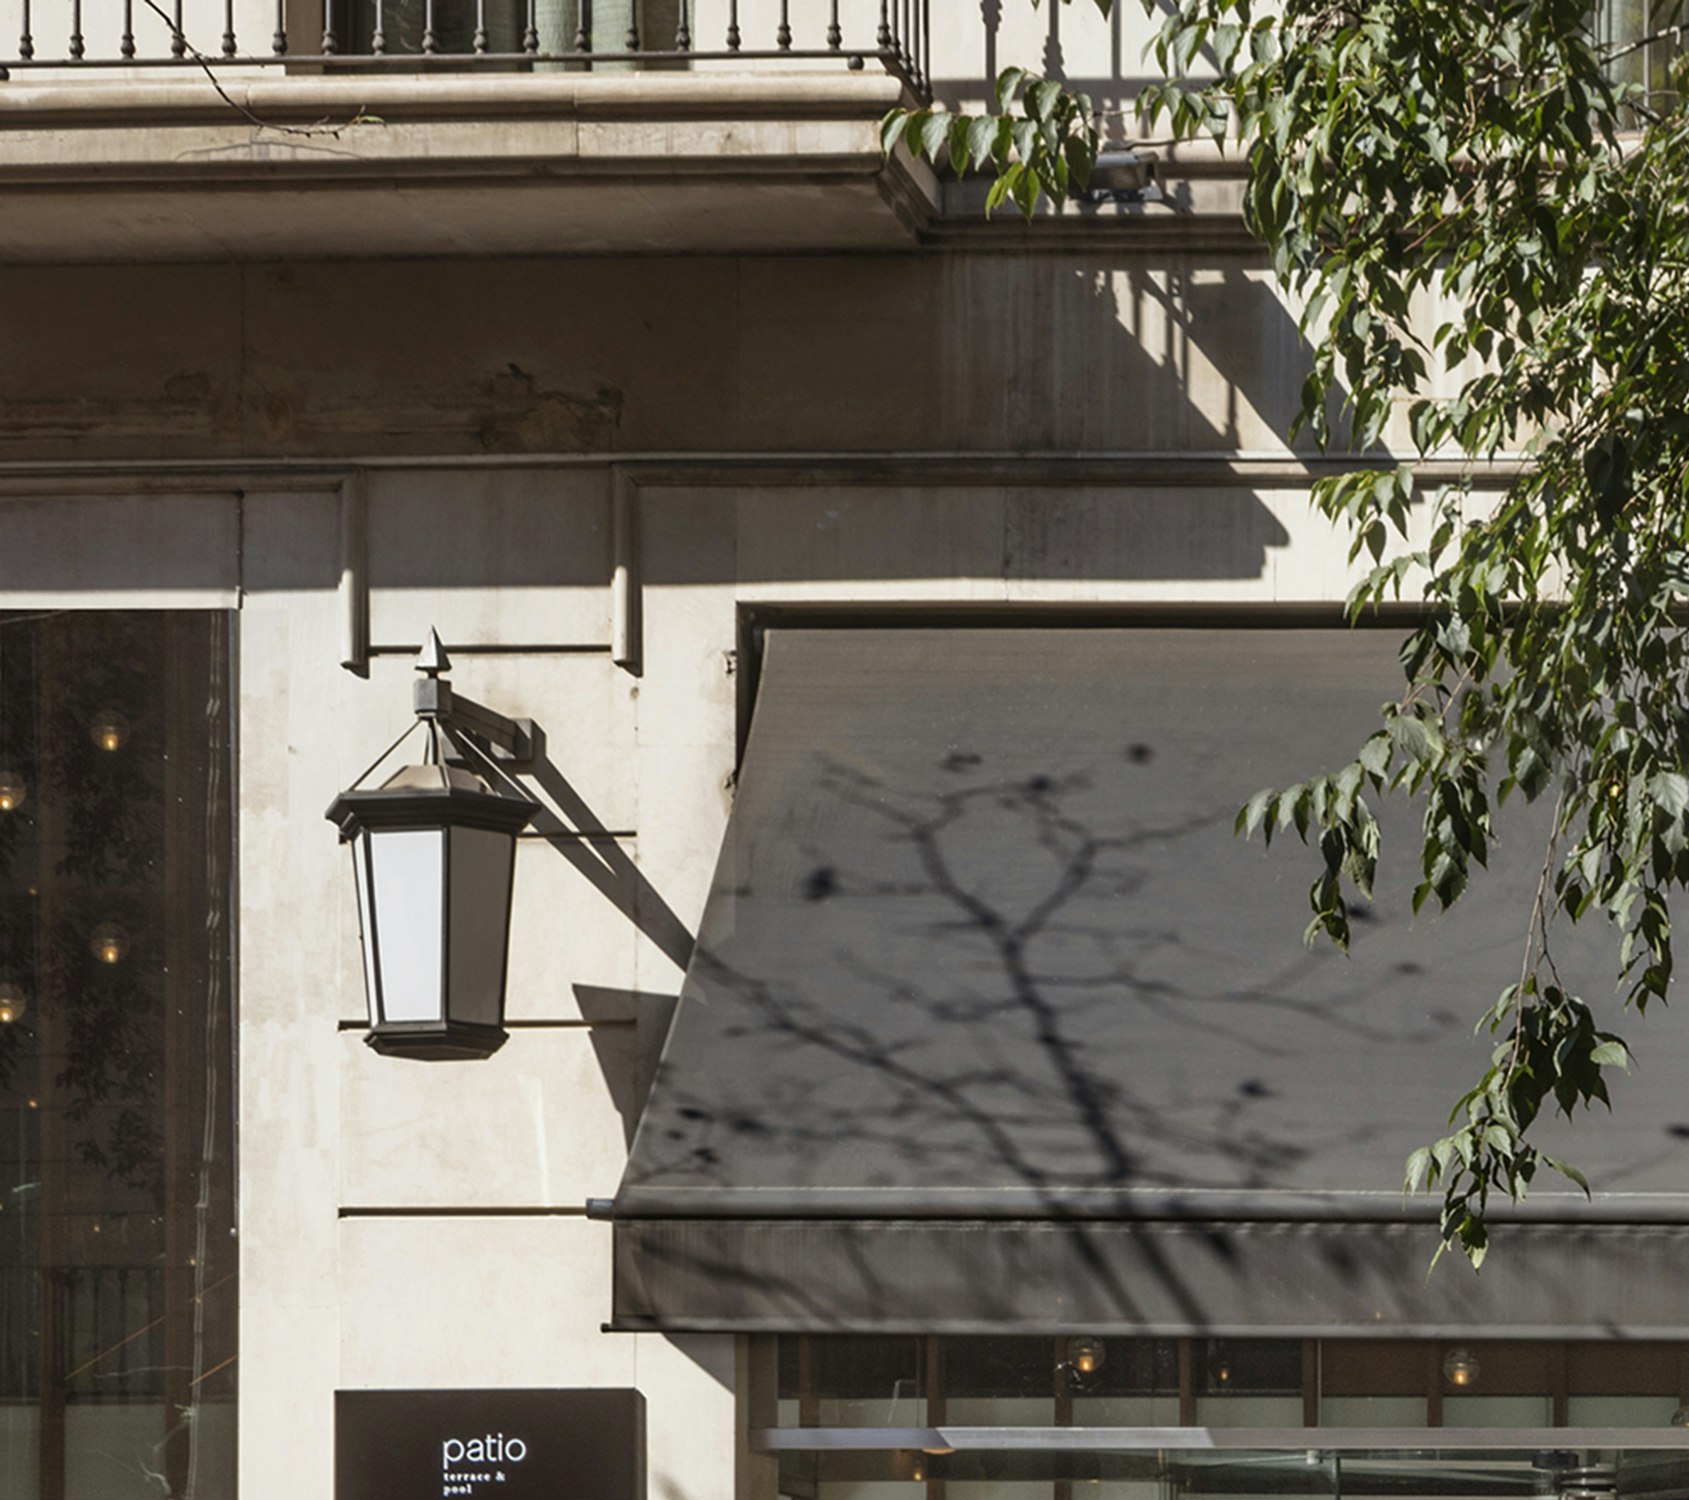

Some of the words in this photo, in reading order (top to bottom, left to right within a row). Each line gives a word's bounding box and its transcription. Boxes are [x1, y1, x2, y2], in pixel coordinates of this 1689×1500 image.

[443, 1432, 527, 1470] patio
[443, 1472, 491, 1482] terrace
[495, 1471, 506, 1482] &
[443, 1483, 472, 1497] pool
